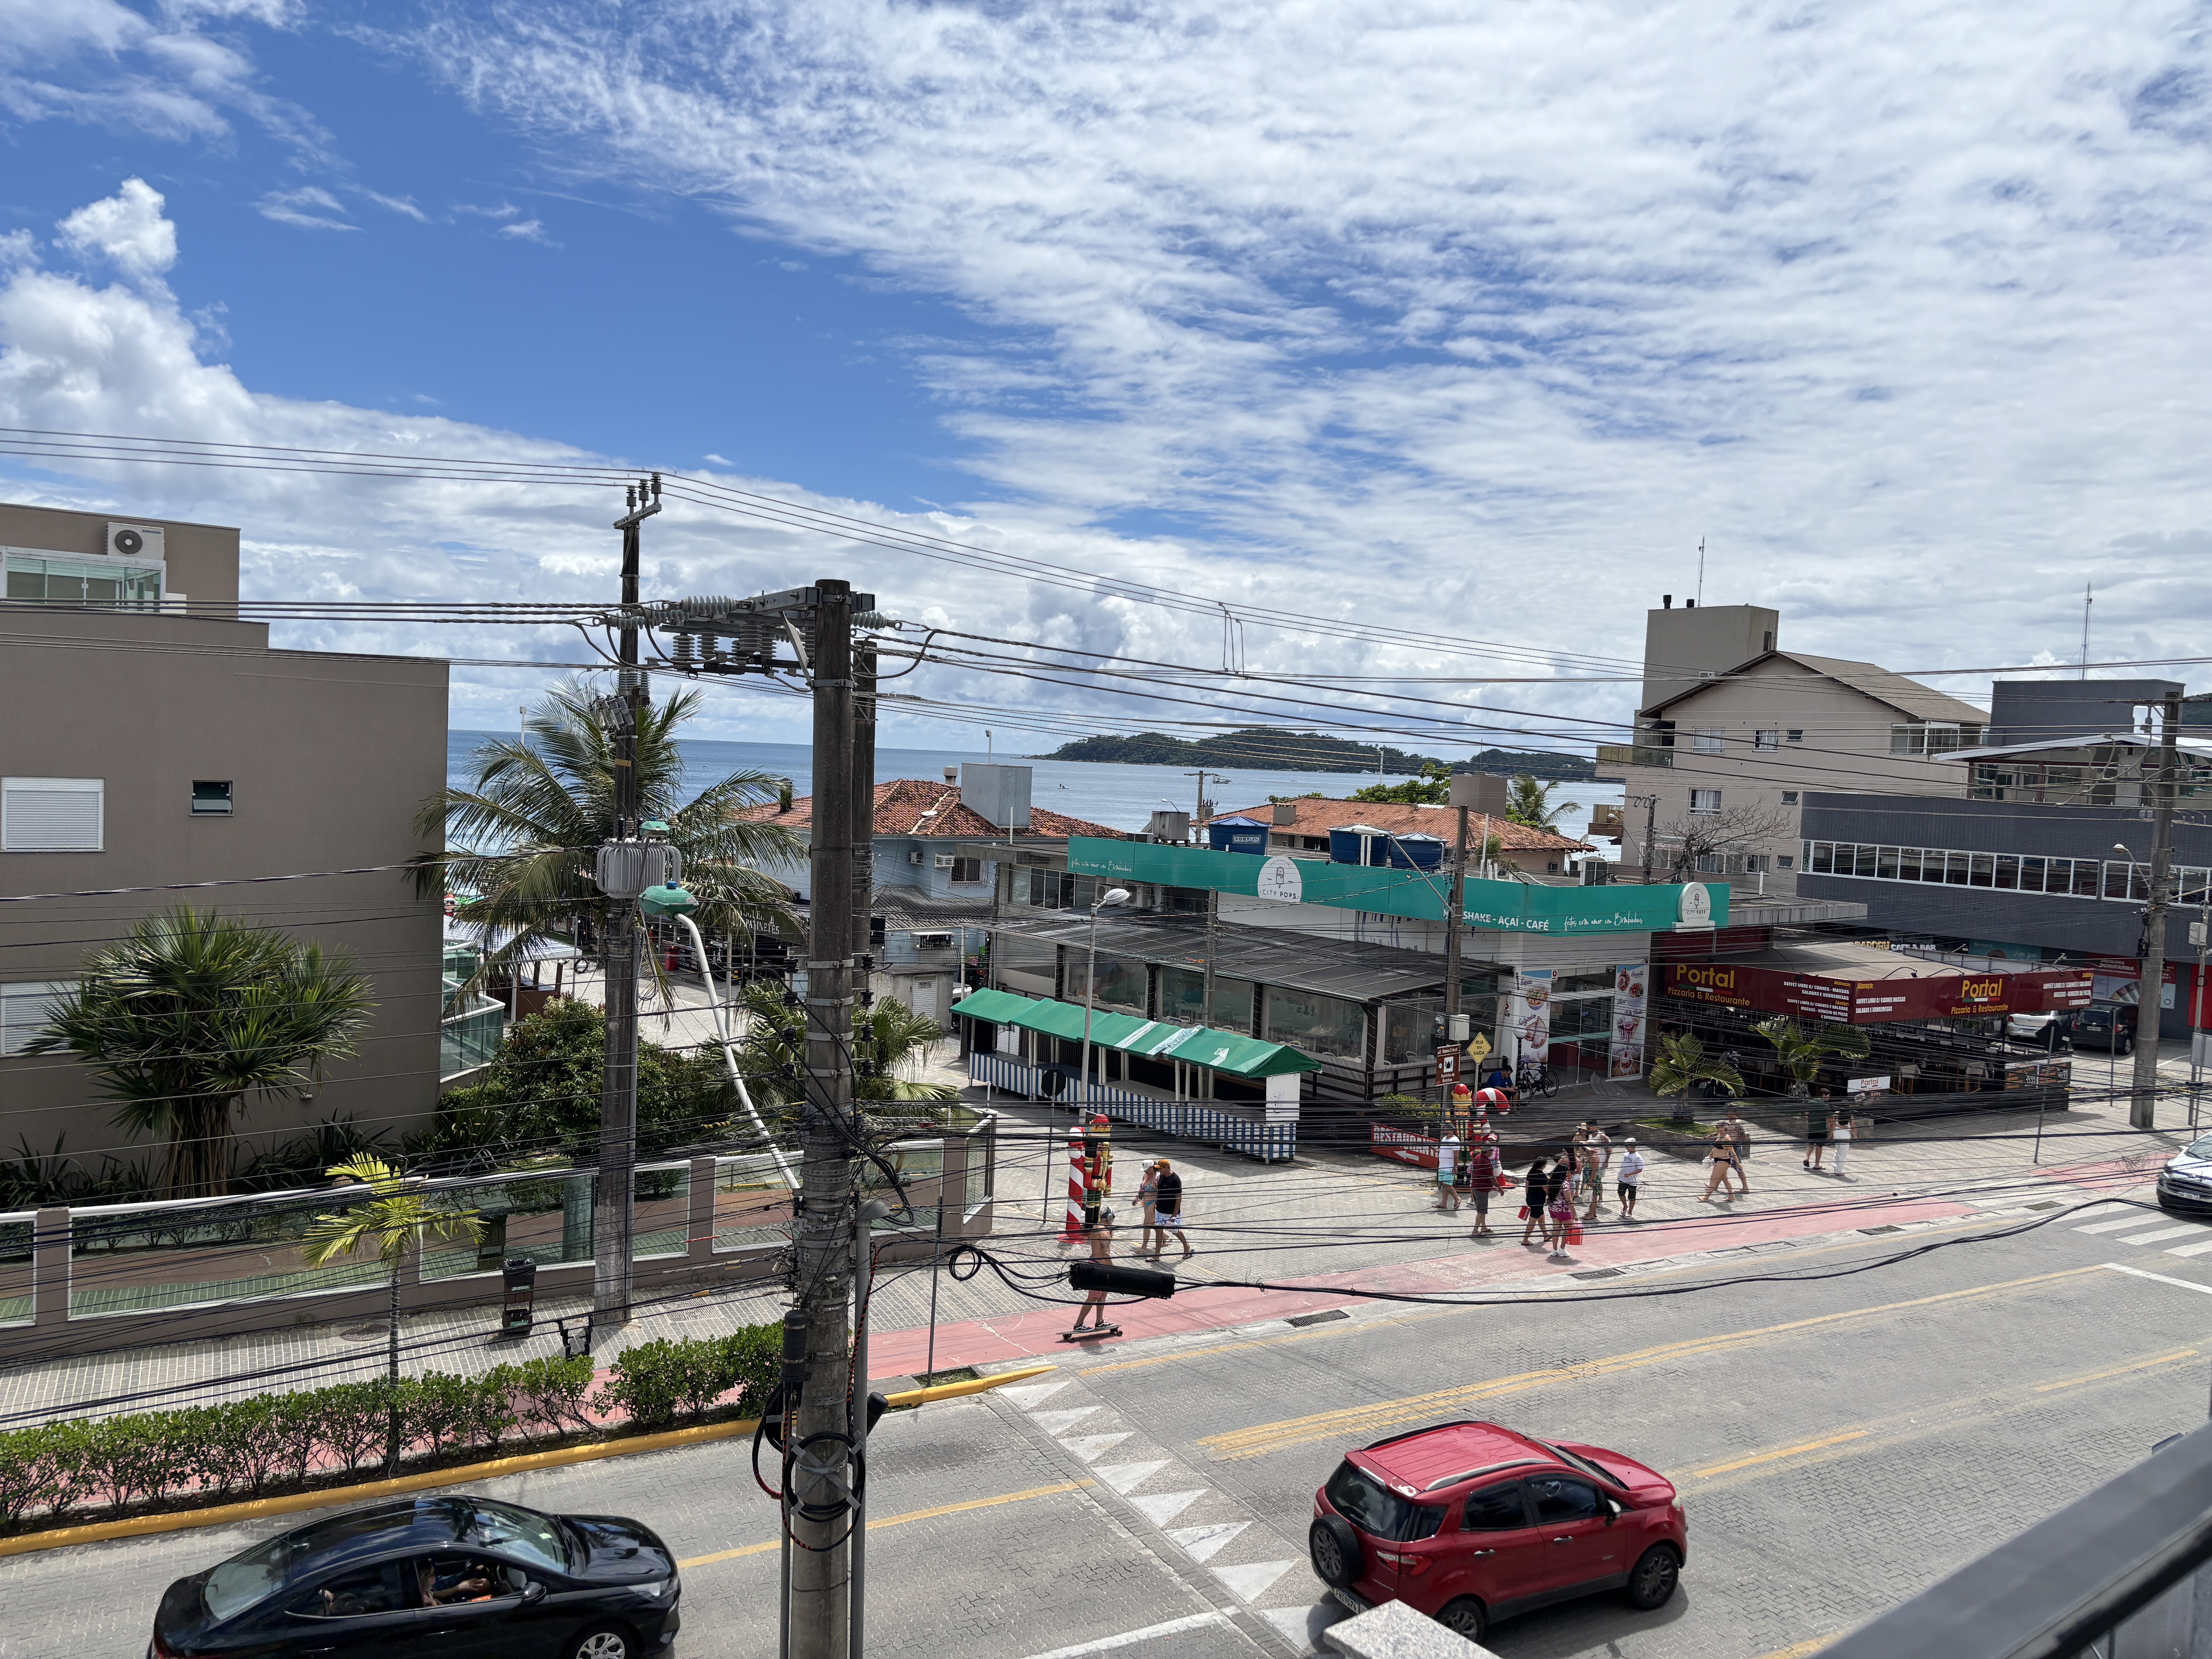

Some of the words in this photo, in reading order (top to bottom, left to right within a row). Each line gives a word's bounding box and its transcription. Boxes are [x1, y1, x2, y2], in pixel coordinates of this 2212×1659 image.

[1498, 916, 1519, 928] AÇAÍ
[1526, 919, 1549, 931] CAFÉ
[1614, 911, 1643, 926] Bombinhas
[1676, 964, 1734, 988] Portal
[1961, 979, 2002, 998] Portal
[1668, 987, 1695, 998] Pizzaria
[1705, 993, 1750, 1006] Restaurante
[1951, 1006, 1970, 1014] Pizzaria
[1978, 1003, 2009, 1012] Restaurante
[1518, 1013, 1536, 1025] Salgados
[1861, 1078, 1878, 1086] Portal
